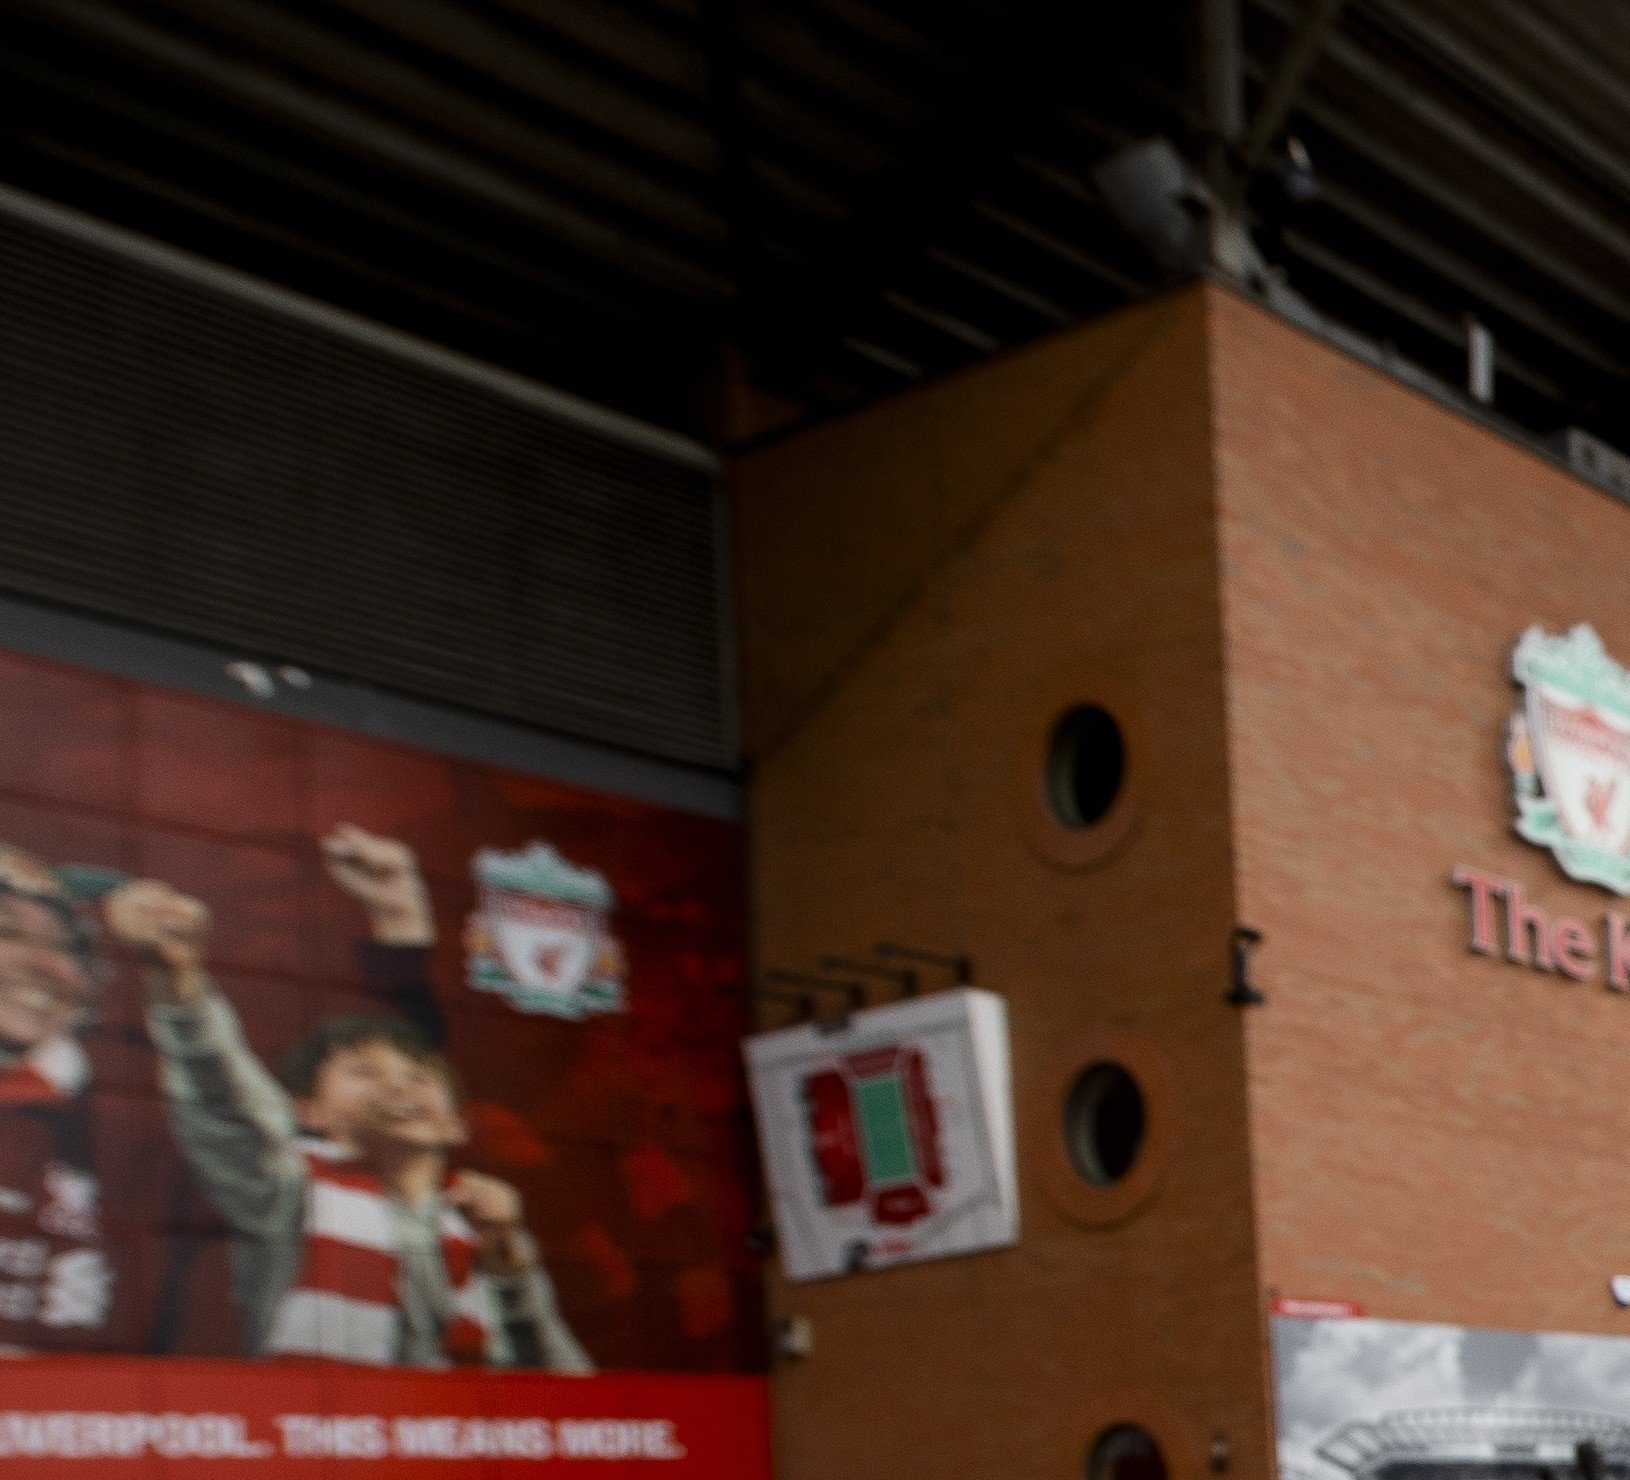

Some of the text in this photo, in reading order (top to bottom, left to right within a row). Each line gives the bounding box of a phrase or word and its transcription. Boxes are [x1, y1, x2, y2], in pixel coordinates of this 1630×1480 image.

[1451, 861, 1597, 982] The
[275, 1414, 389, 1459] THIS
[397, 1415, 553, 1460] MEANS
